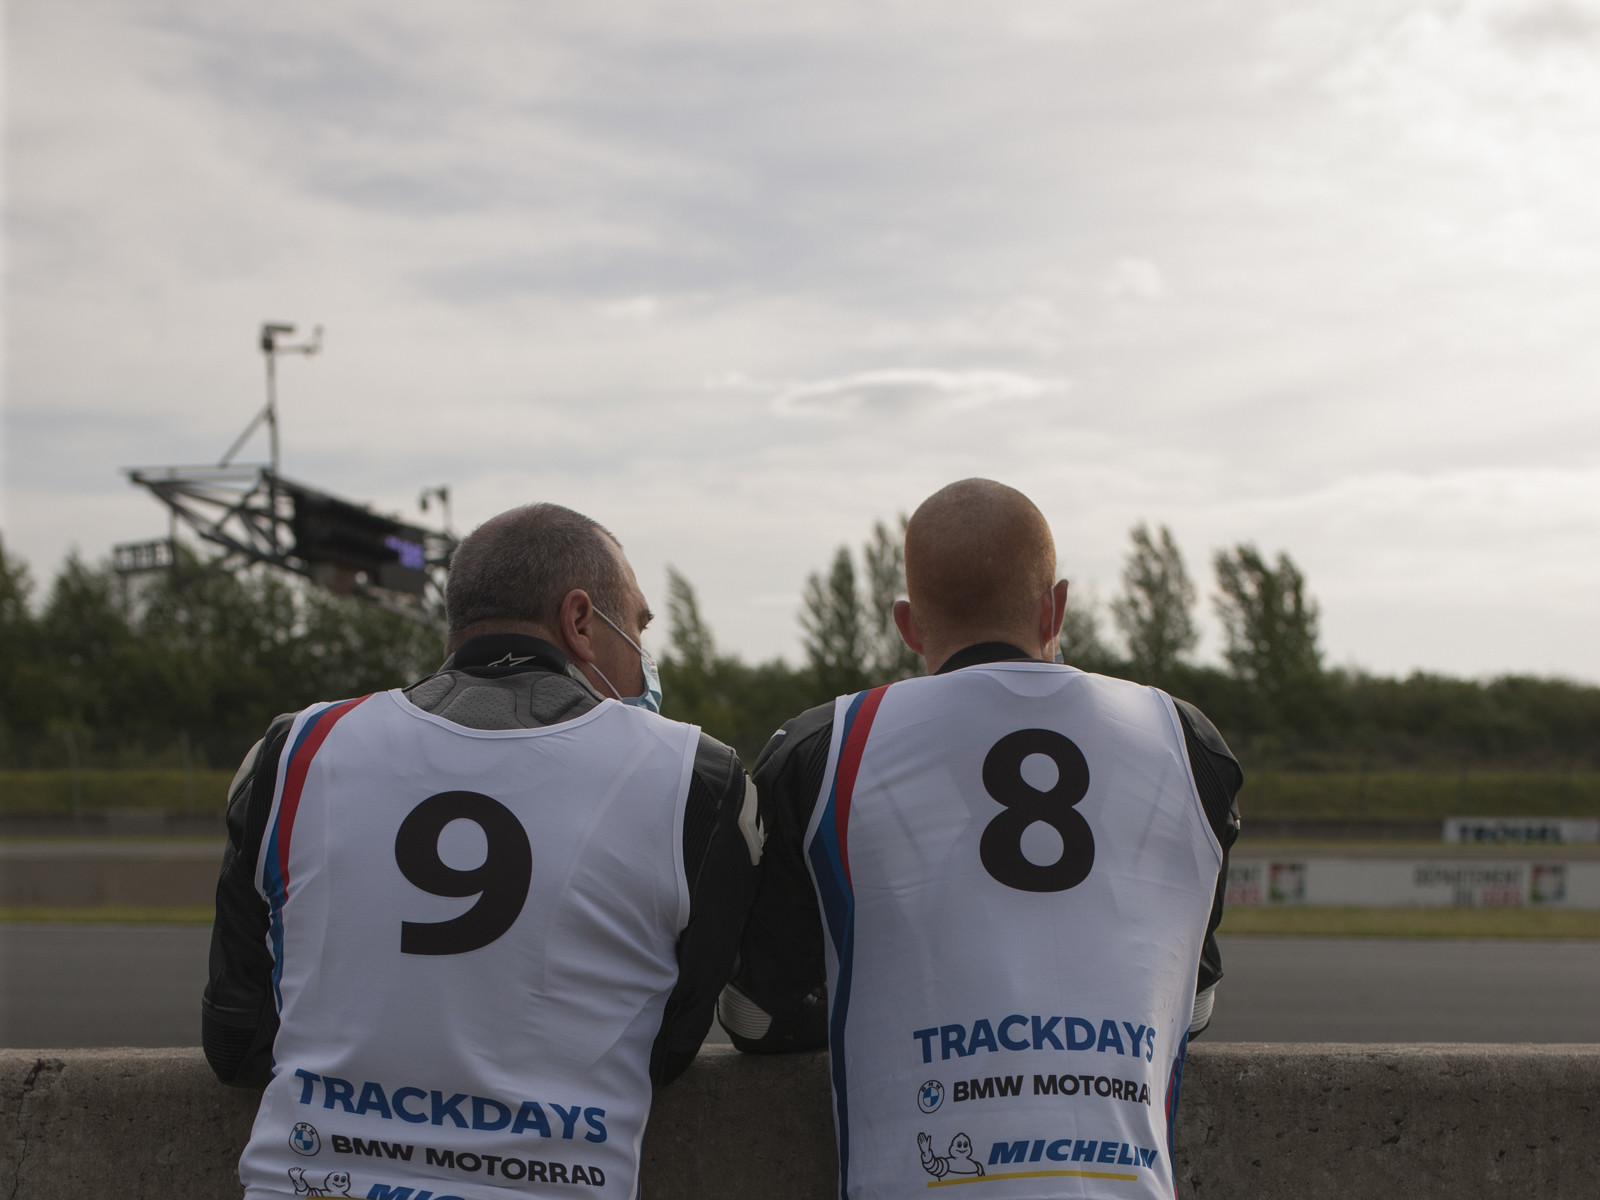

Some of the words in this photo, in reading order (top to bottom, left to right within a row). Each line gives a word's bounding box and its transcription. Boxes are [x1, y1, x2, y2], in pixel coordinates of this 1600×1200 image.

[979, 728, 1095, 893] 8
[395, 790, 533, 956] 9
[913, 1014, 1156, 1063] TRACKDAYS
[294, 1068, 608, 1144] TRACKDAYS
[953, 1075, 1024, 1102] BMW
[1033, 1074, 1151, 1107] MOTORRA
[331, 1135, 414, 1161] BMW
[425, 1147, 606, 1187] MOTORRAD
[988, 1139, 1158, 1169] MICHELIN
